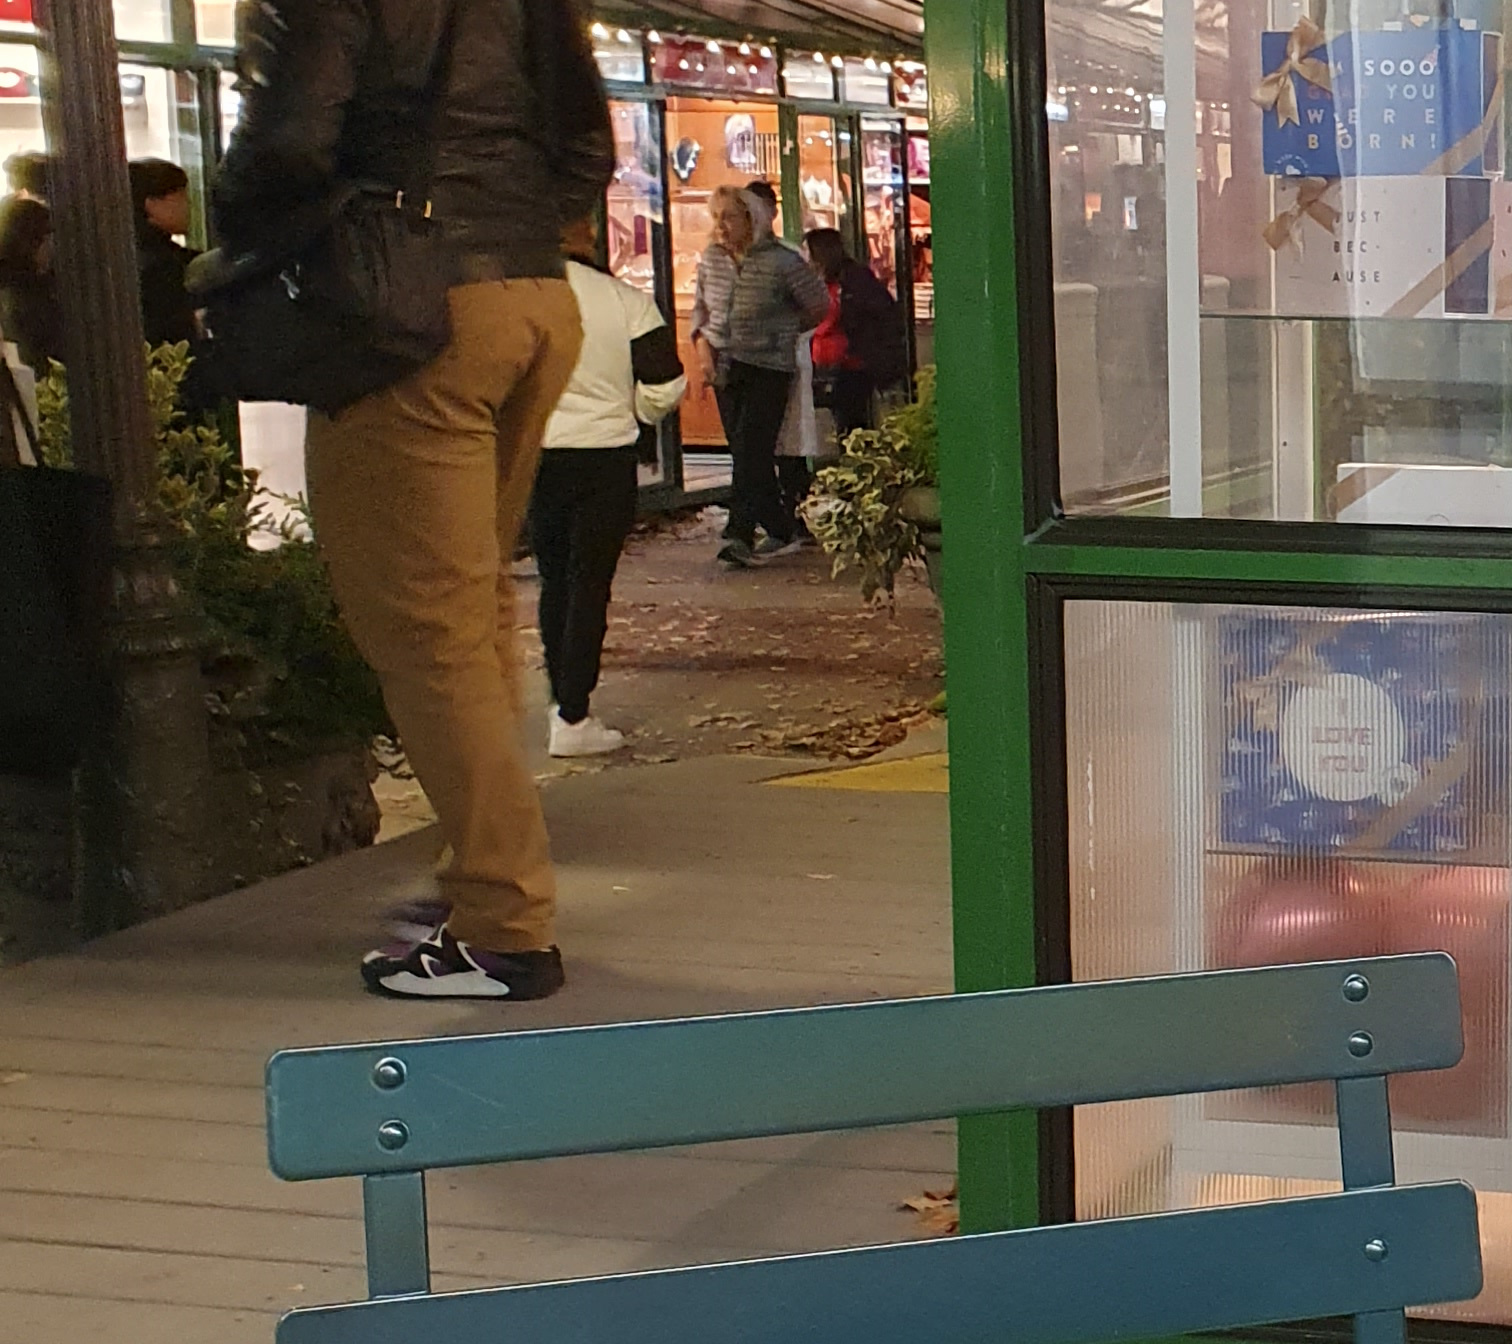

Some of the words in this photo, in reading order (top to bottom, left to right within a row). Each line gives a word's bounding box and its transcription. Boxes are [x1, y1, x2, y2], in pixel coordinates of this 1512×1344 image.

[1364, 59, 1437, 76] SOOO
[1387, 84, 1436, 100] YOU
[1307, 108, 1436, 125] WERE
[1307, 133, 1436, 150] BORN!
[1332, 270, 1381, 283] AUSE
